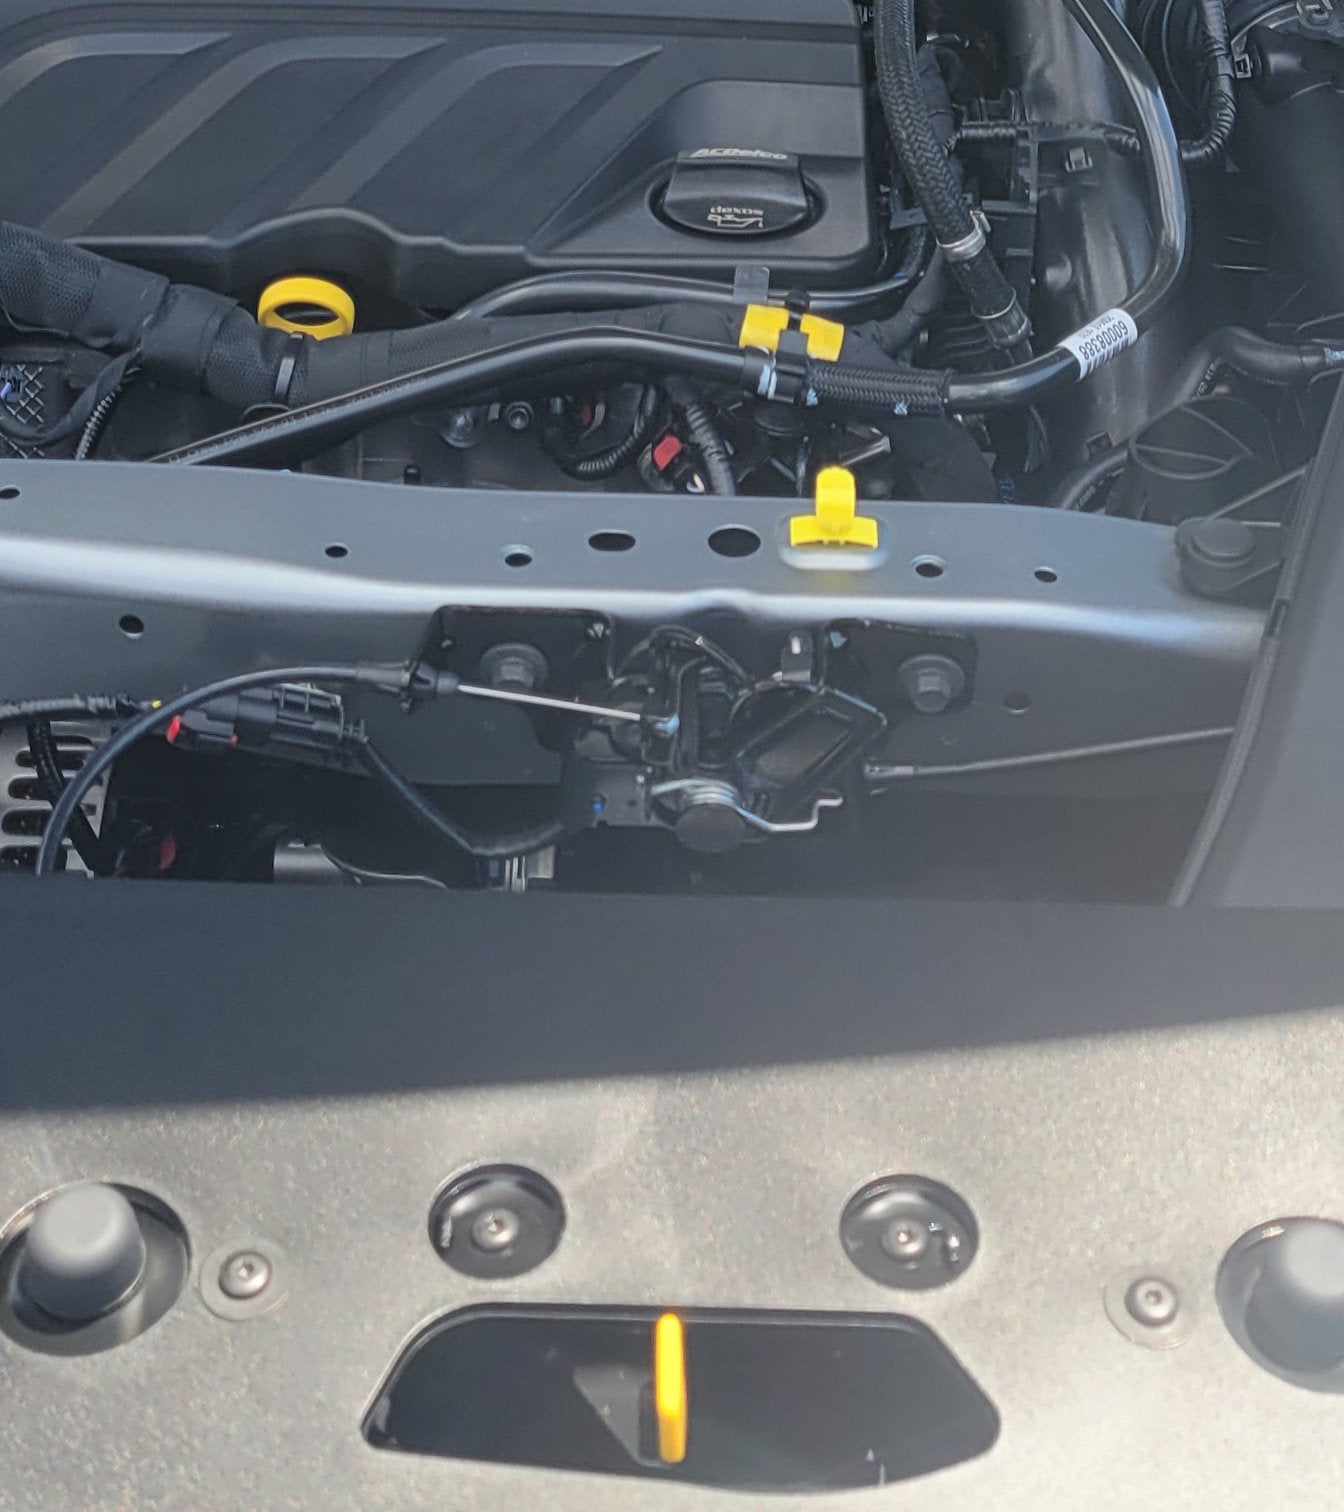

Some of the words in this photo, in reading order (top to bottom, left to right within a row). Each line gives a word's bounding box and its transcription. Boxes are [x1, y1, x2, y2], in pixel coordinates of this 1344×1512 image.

[689, 147, 789, 160] ACDelco
[710, 206, 764, 216] dexos
[1078, 320, 1129, 361] 60008388
